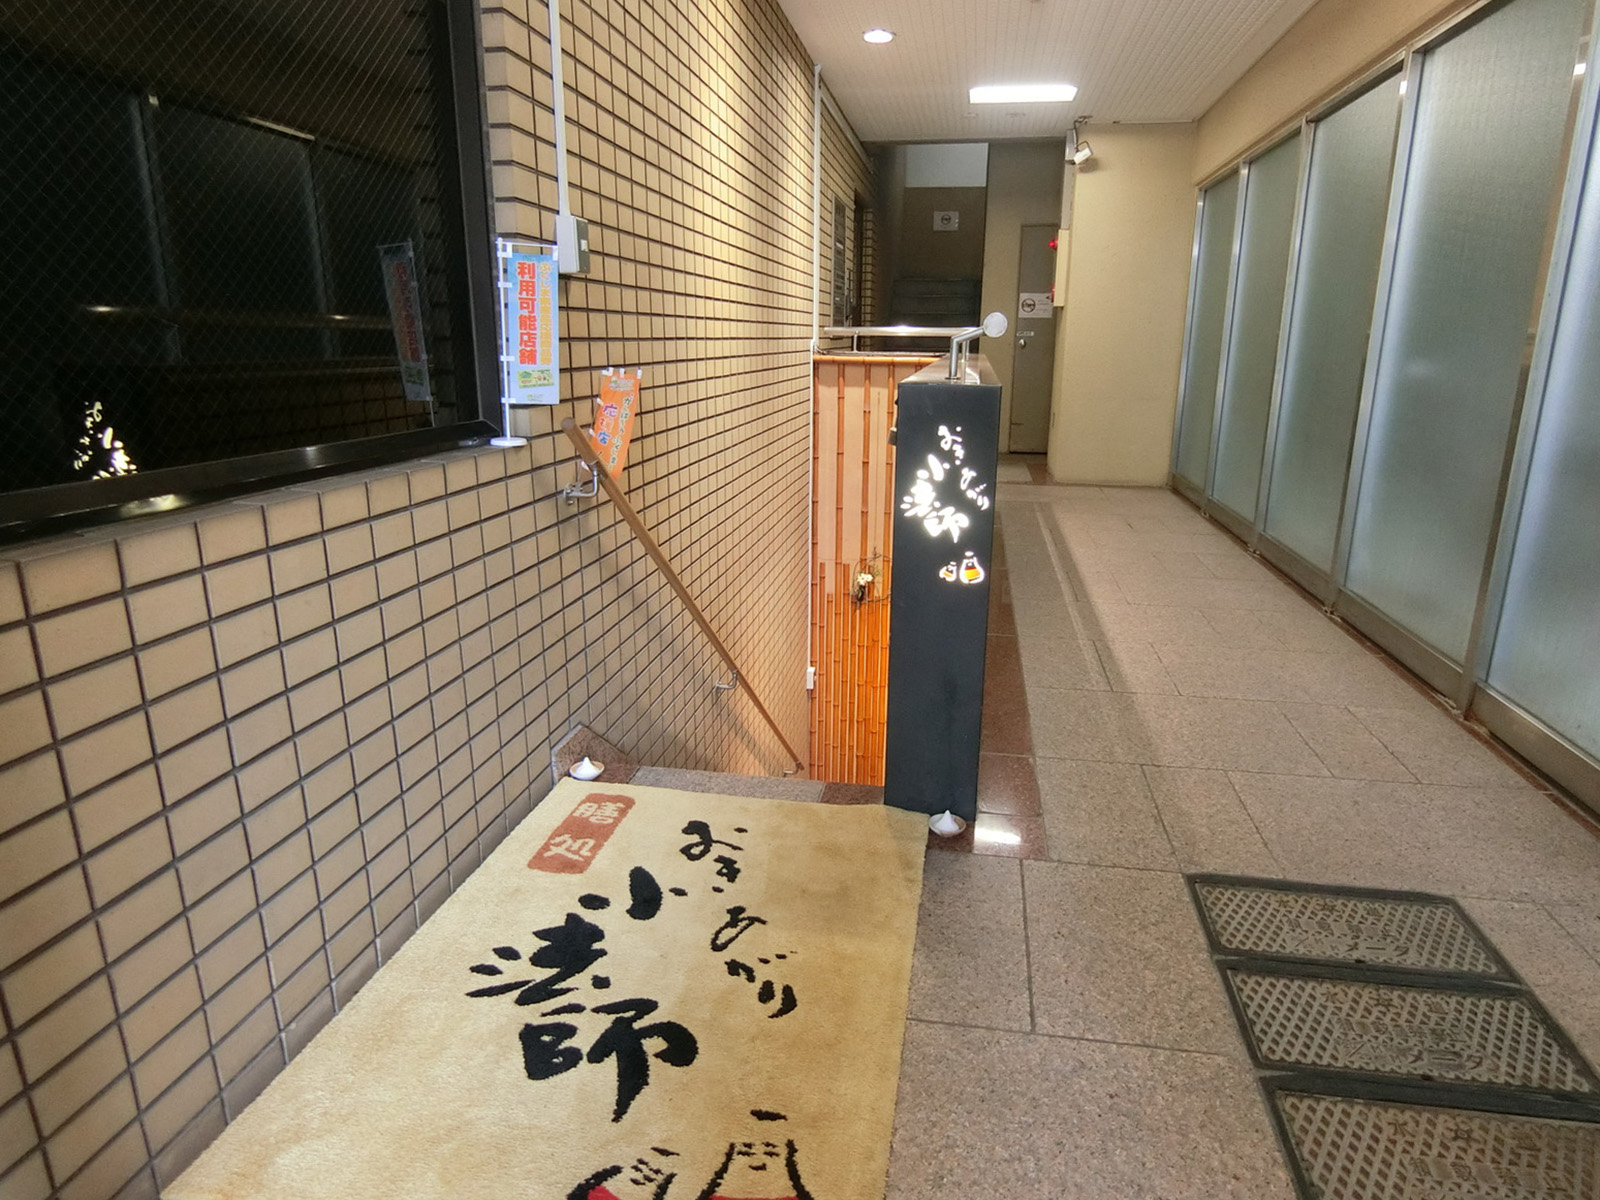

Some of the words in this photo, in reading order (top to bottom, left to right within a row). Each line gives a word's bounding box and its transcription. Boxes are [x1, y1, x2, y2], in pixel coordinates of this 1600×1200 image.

[517, 261, 537, 366] 利用可能店舗
[465, 865, 699, 1122] 小法師
